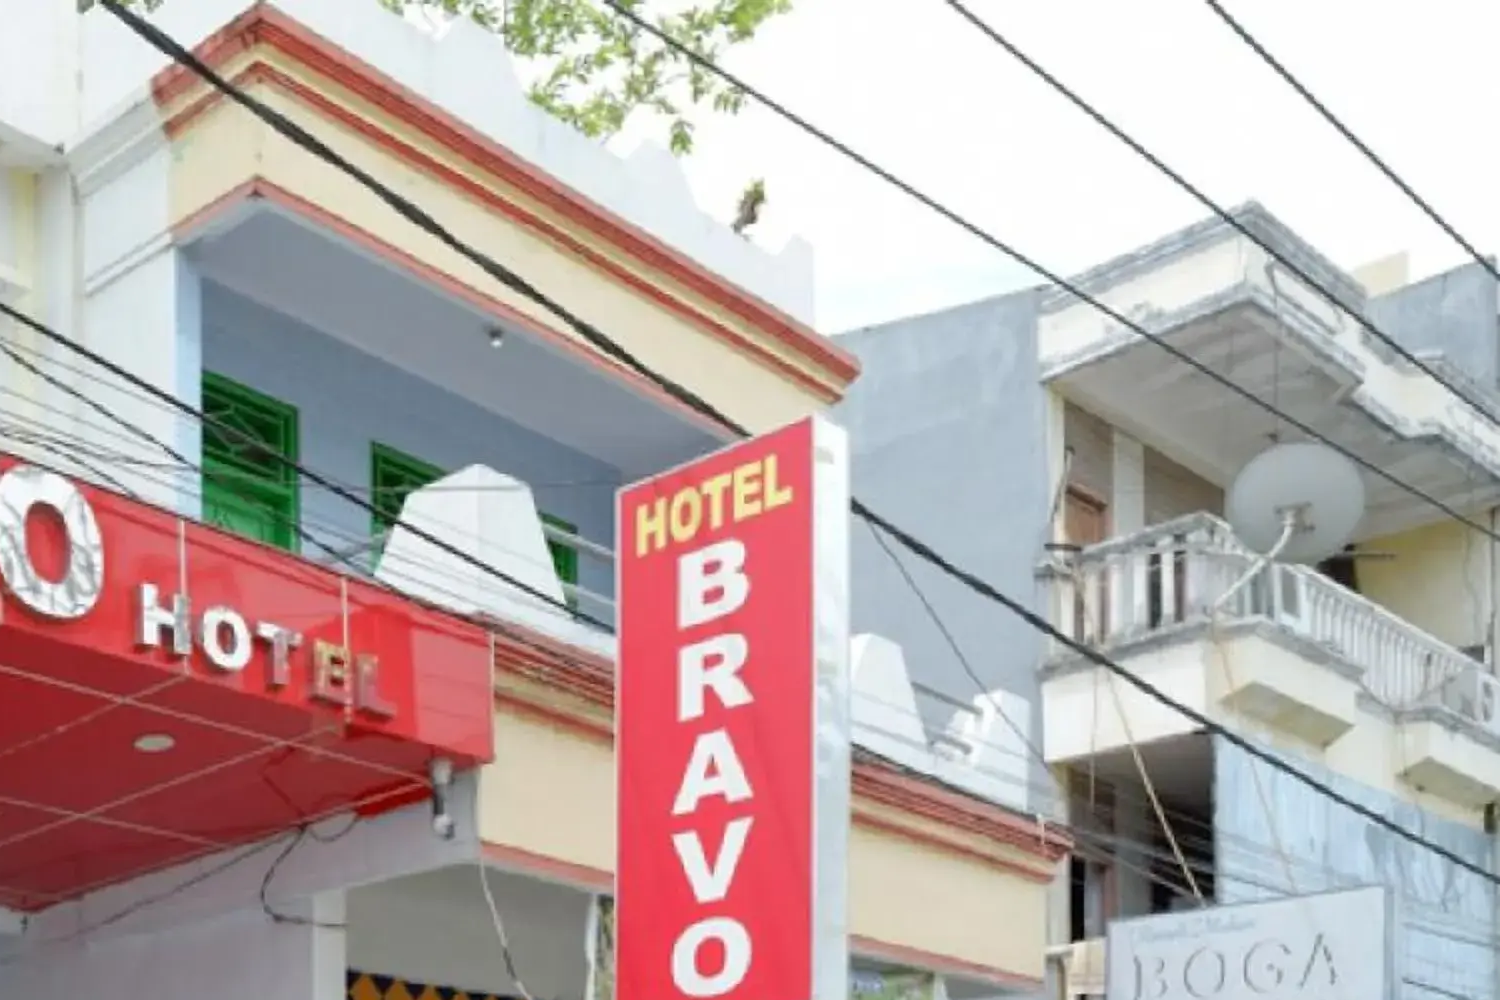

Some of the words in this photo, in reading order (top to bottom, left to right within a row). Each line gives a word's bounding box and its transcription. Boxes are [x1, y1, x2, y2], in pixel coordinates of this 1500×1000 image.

[634, 453, 794, 558] HOTEL
[134, 583, 394, 717] HOTEL
[670, 537, 755, 1000] BRAVO
